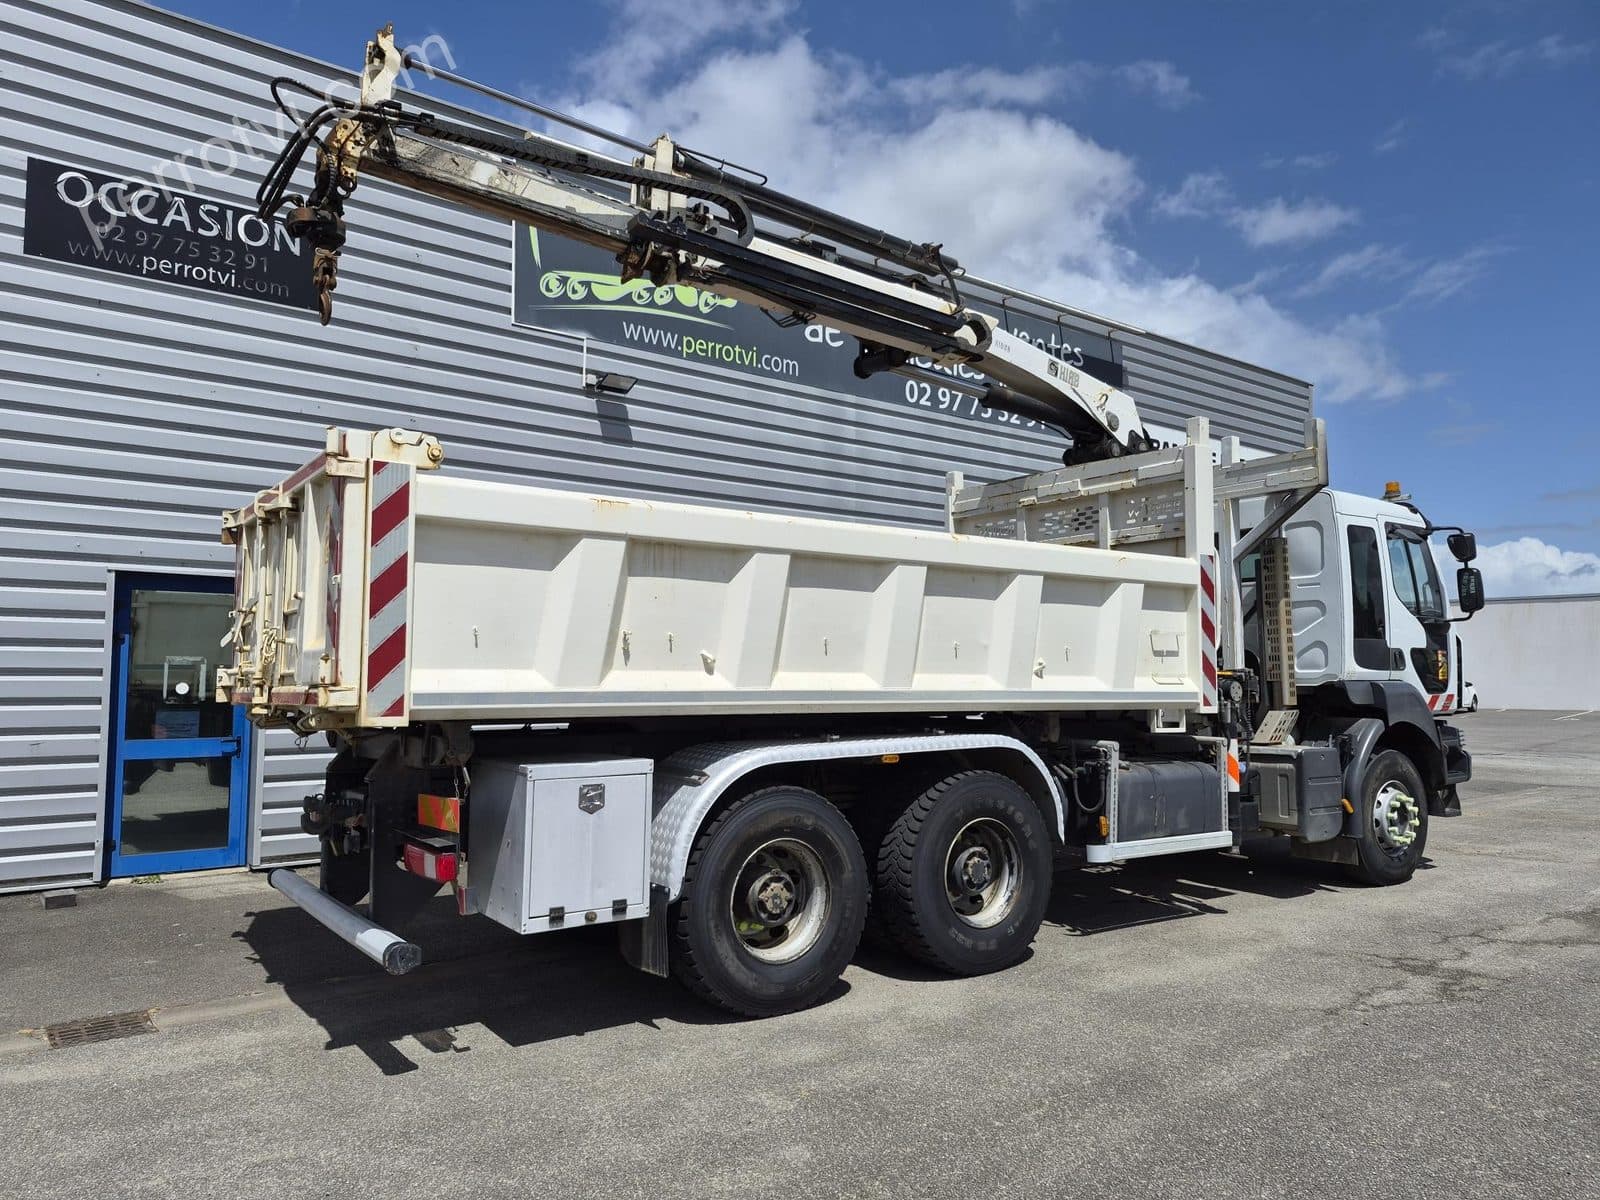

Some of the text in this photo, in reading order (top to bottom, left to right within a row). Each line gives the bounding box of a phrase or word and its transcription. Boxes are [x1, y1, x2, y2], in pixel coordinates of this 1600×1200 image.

[54, 171, 301, 257] OCCASION
[67, 239, 290, 298] www.perrotvi.com
[95, 221, 269, 273] 02 97 75 32 91
[622, 320, 800, 377] www.perrotvi.com
[905, 379, 932, 407] 02
[937, 387, 964, 412] 97
